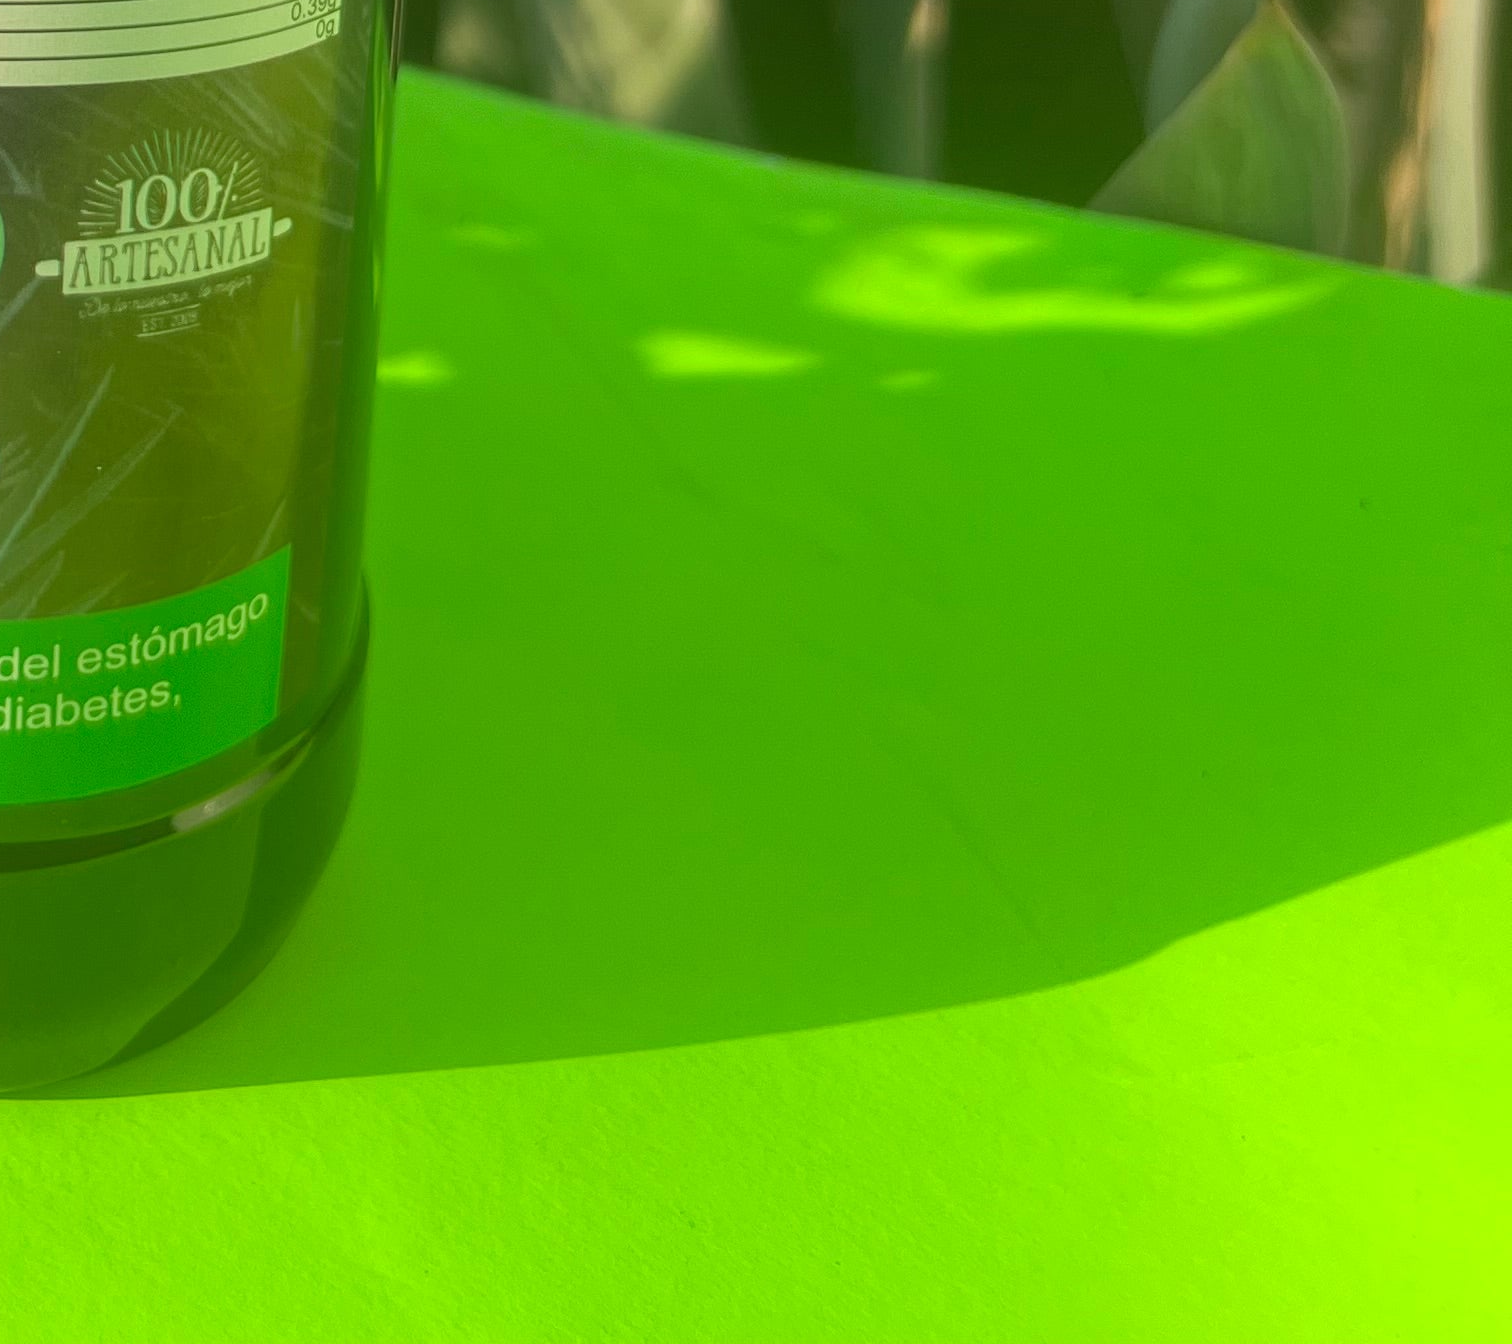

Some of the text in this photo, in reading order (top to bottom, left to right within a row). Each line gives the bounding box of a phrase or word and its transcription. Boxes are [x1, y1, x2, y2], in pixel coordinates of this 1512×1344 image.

[315, 18, 335, 39] 0g
[68, 216, 266, 289] ARTESANAL
[76, 593, 269, 674] estómago
